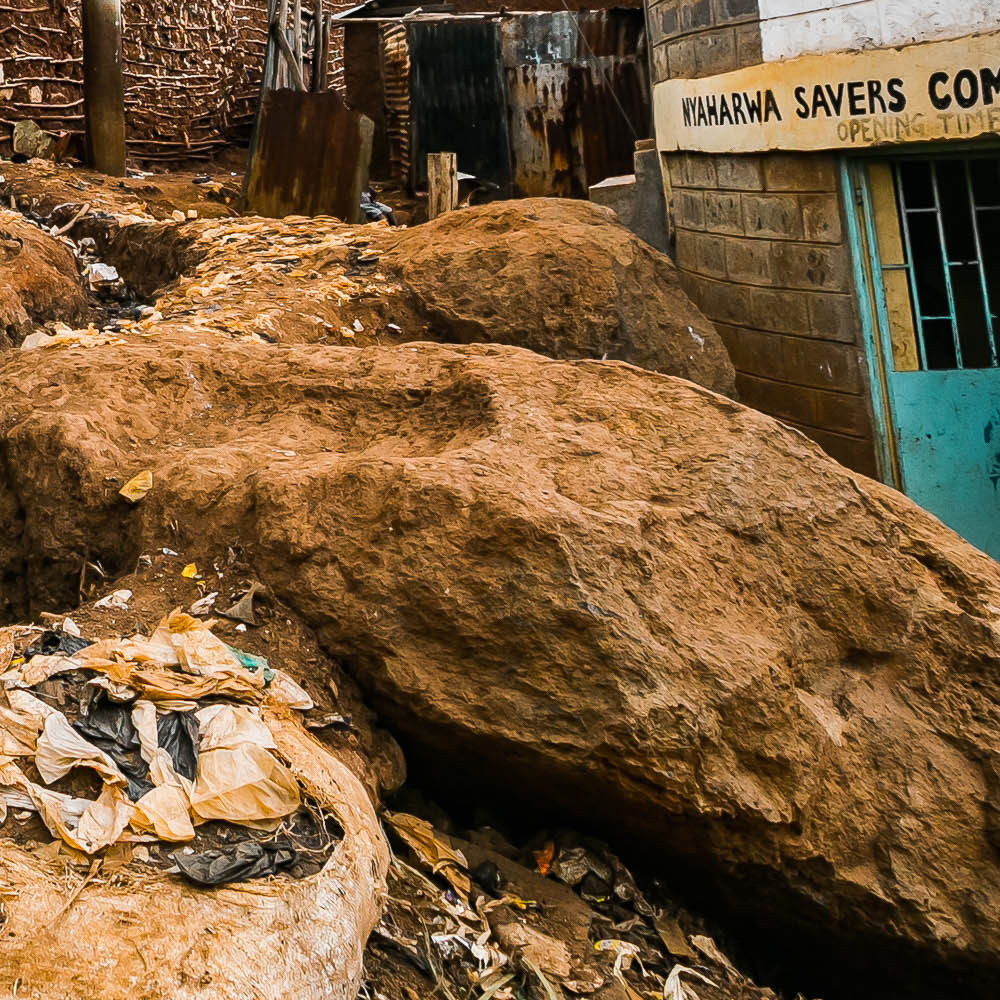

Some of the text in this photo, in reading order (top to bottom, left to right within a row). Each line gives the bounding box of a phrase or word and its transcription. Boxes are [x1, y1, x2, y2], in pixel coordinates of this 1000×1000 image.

[681, 67, 1000, 128] NYAHARWA SAVERS COM
[837, 112, 925, 143] OPENING
